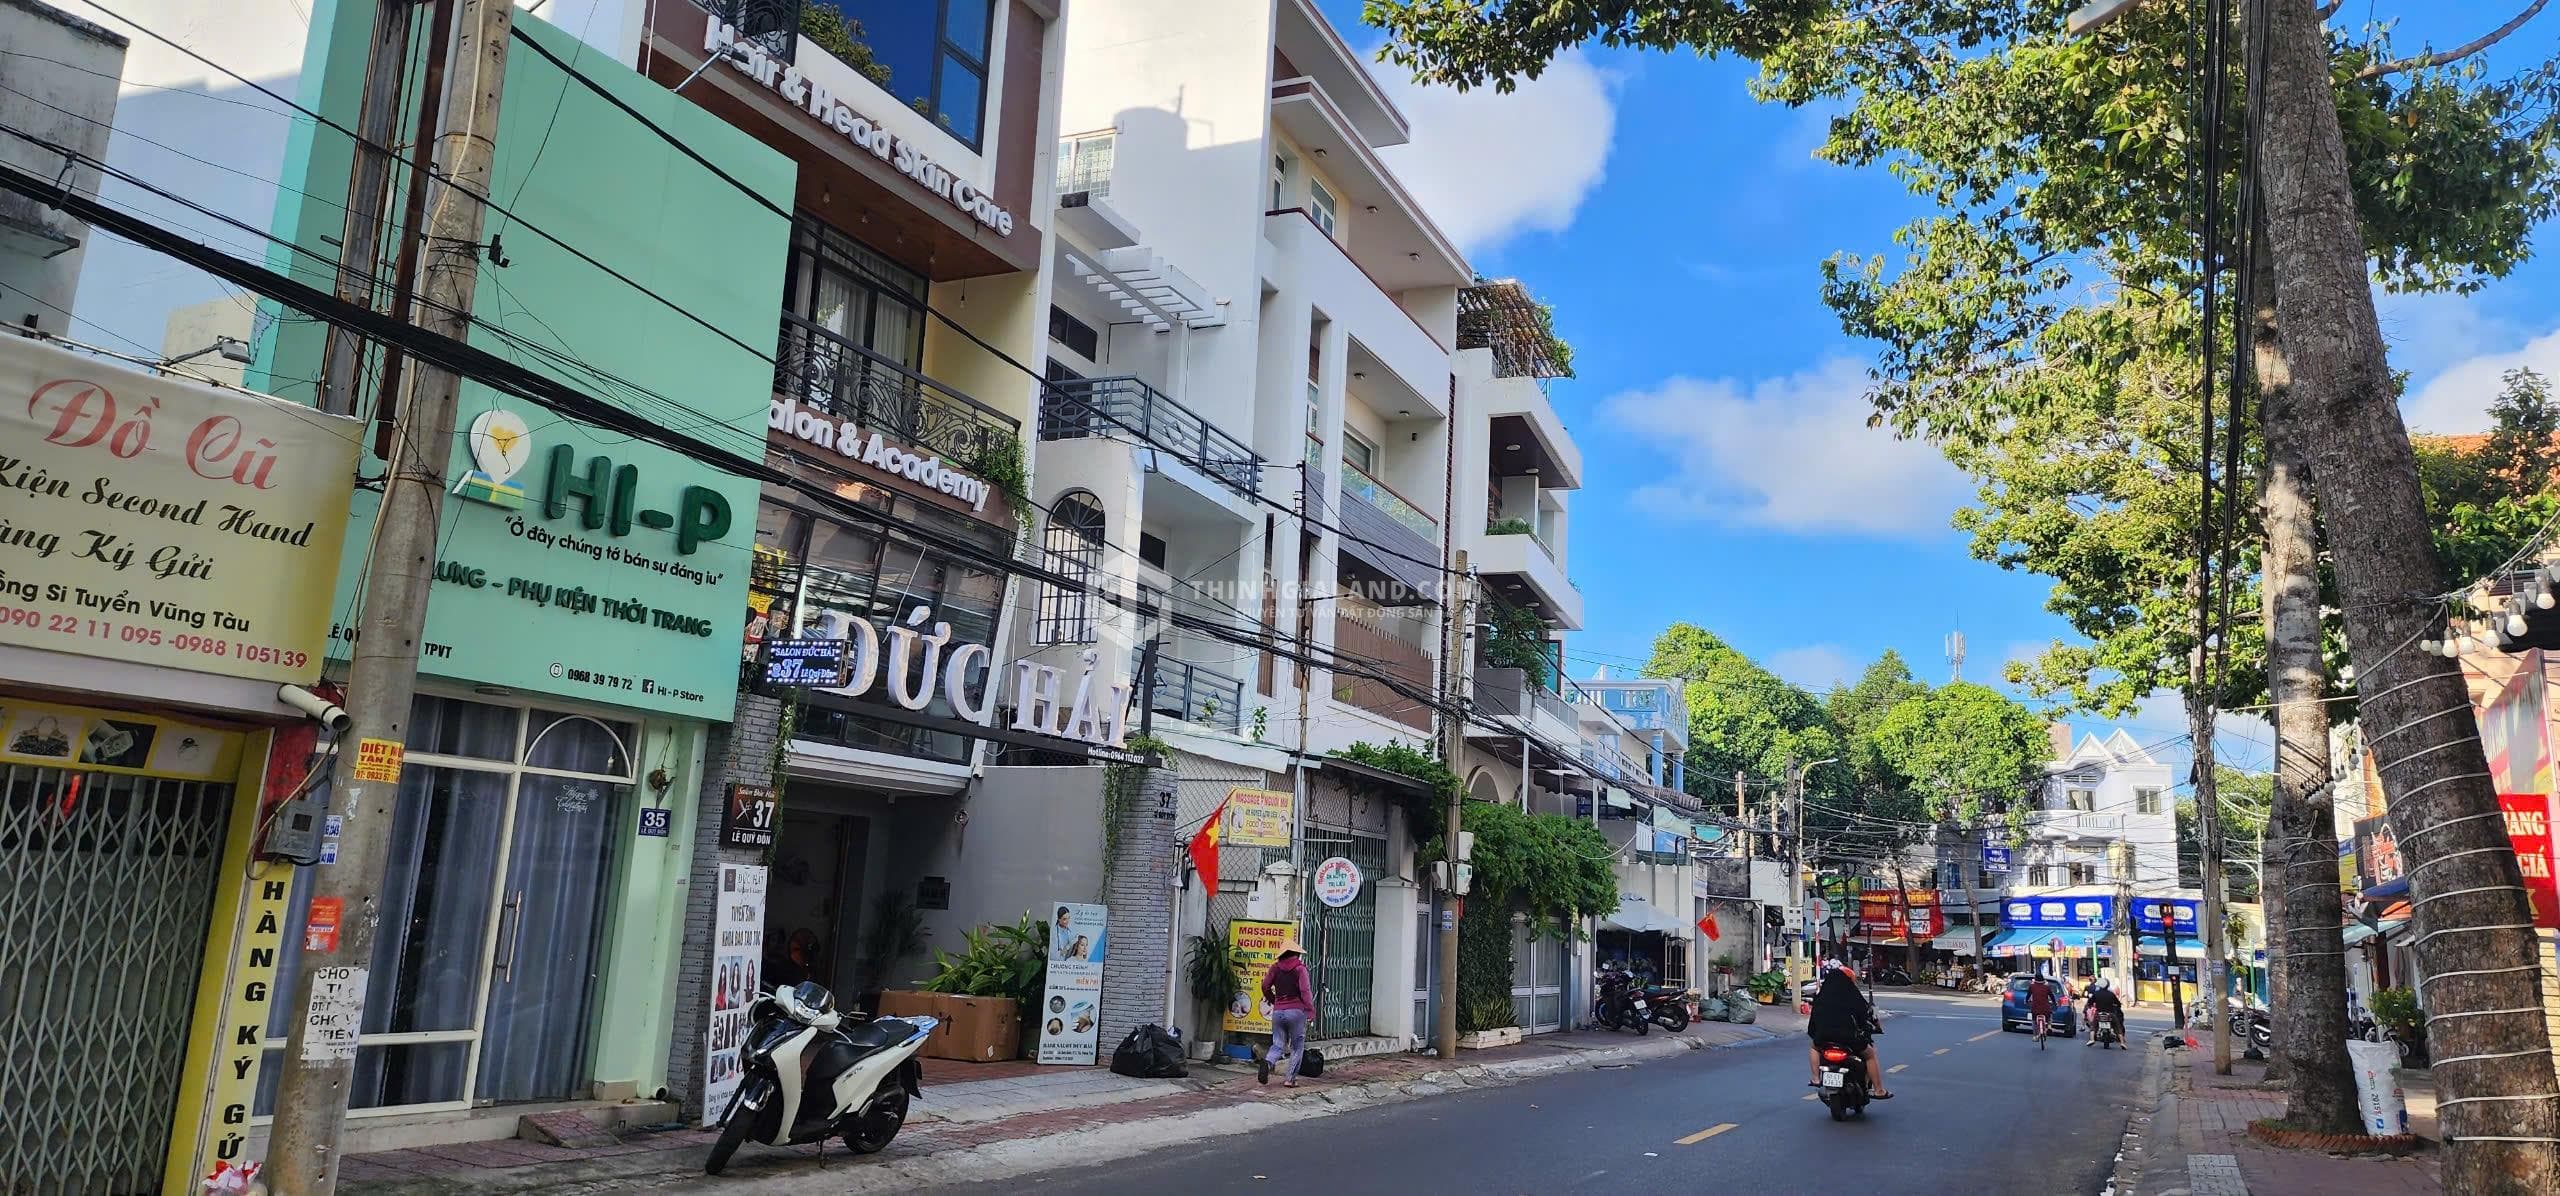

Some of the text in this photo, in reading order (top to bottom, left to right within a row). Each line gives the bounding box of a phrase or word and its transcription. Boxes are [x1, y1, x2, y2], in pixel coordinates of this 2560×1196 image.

[704, 14, 1013, 238] Hair & Head Skin Care
[28, 379, 278, 490] Đồ Cũ
[836, 423, 861, 459] &
[862, 433, 991, 512] Academy
[82, 477, 208, 526] Second
[218, 504, 314, 548] Hand
[544, 443, 732, 555] HI-P
[72, 529, 135, 571] Ký
[145, 545, 215, 580] Gửi
[526, 525, 555, 549] đây
[559, 534, 602, 560] chúng
[606, 546, 621, 561] tớ
[623, 549, 649, 569] bán
[652, 561, 668, 576] sự
[669, 562, 703, 585] đáng
[46, 584, 67, 602] Si
[76, 588, 140, 614] Tuyển
[150, 600, 205, 629] Vũng
[213, 611, 250, 632] Tàu
[432, 561, 487, 588] ƯNG
[507, 577, 552, 607] PHỤ
[555, 586, 597, 615] KIỆN
[602, 597, 647, 625] THỜI
[652, 609, 713, 638] TRANG
[0, 606, 41, 628] 090
[48, 614, 78, 634] 22
[88, 619, 111, 639] 11
[121, 625, 161, 646] 095
[236, 643, 308, 668] 105139
[424, 642, 452, 658] TPVT
[776, 647, 801, 657] SALON
[568, 668, 633, 690] 0968 39 79 72
[780, 659, 804, 678] 37
[680, 690, 704, 702] Store
[1014, 648, 1132, 748] HẢI
[645, 811, 666, 828] 35
[753, 800, 775, 828] 37
[1160, 792, 1171, 808] 37
[732, 831, 740, 842] LÊ
[741, 832, 756, 844] QUÝ
[245, 881, 284, 1001] HÀNG
[1238, 927, 1284, 936] MASSAGE
[318, 968, 349, 980] CHO
[233, 1024, 259, 1080] KÝ
